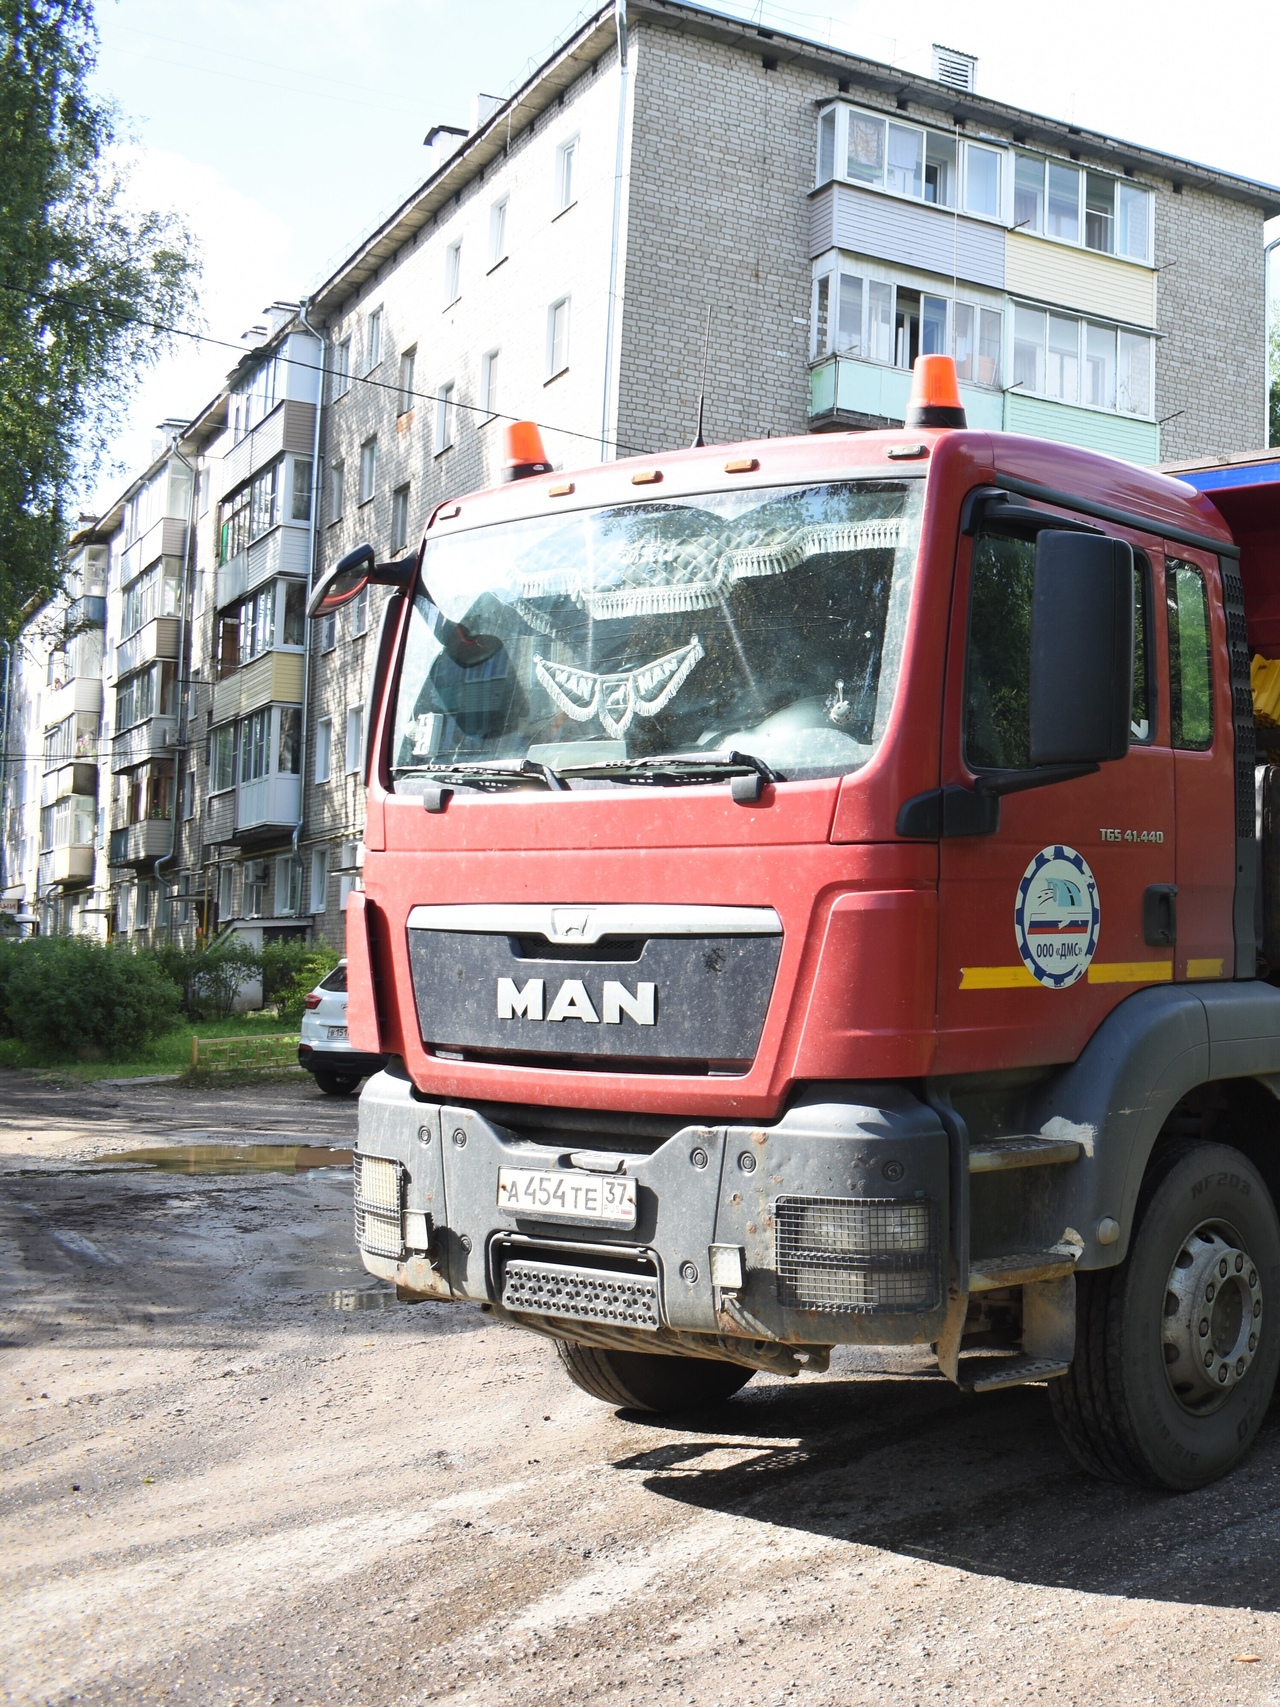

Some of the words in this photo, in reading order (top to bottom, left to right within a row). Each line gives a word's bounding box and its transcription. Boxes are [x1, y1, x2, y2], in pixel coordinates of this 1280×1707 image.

[1100, 828, 1121, 841] TGS
[1124, 830, 1164, 844] 41.440
[1036, 943, 1054, 958] ООО
[497, 977, 657, 1026] MAN
[605, 1181, 627, 1206] 37
[603, 1205, 620, 1214] RUS
